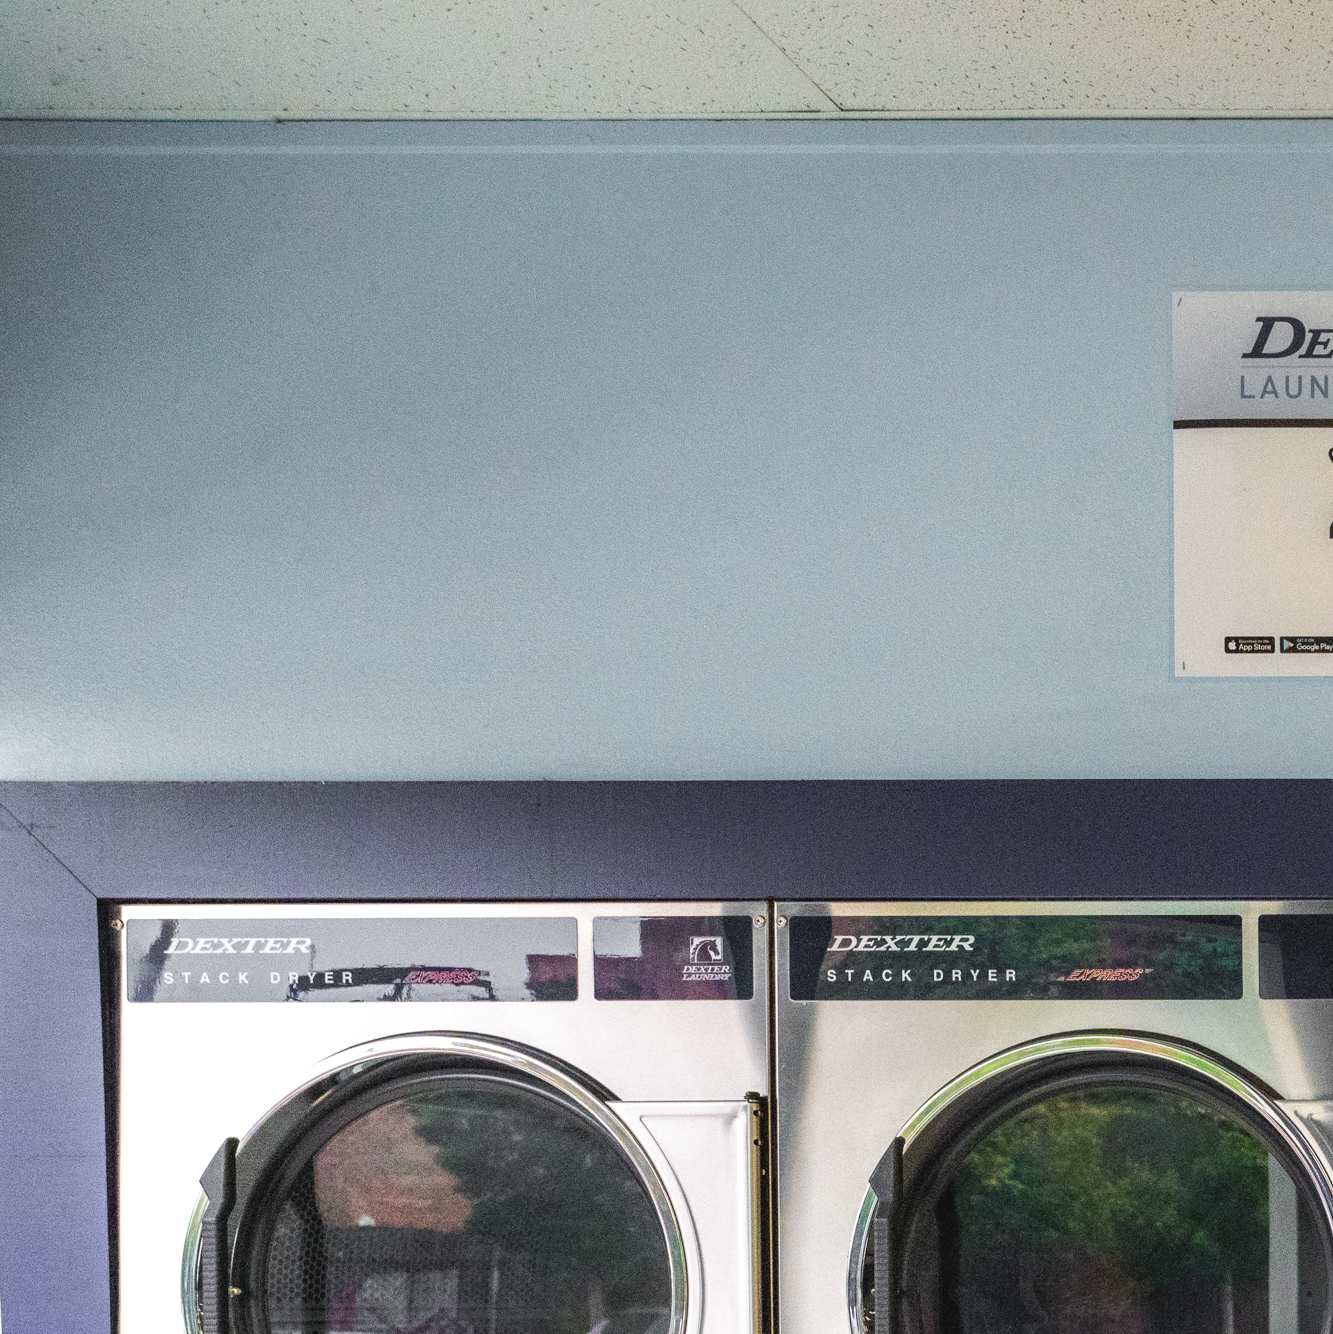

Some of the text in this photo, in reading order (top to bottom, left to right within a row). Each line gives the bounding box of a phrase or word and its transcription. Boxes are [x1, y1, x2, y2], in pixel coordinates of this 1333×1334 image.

[1237, 642, 1273, 651] App Store
[1295, 642, 1333, 653] Google Play
[164, 937, 312, 956] DEXTER
[827, 934, 975, 952] DEXTER
[163, 969, 353, 985] STACK DRYER
[827, 968, 1016, 982] STACK DRYER
